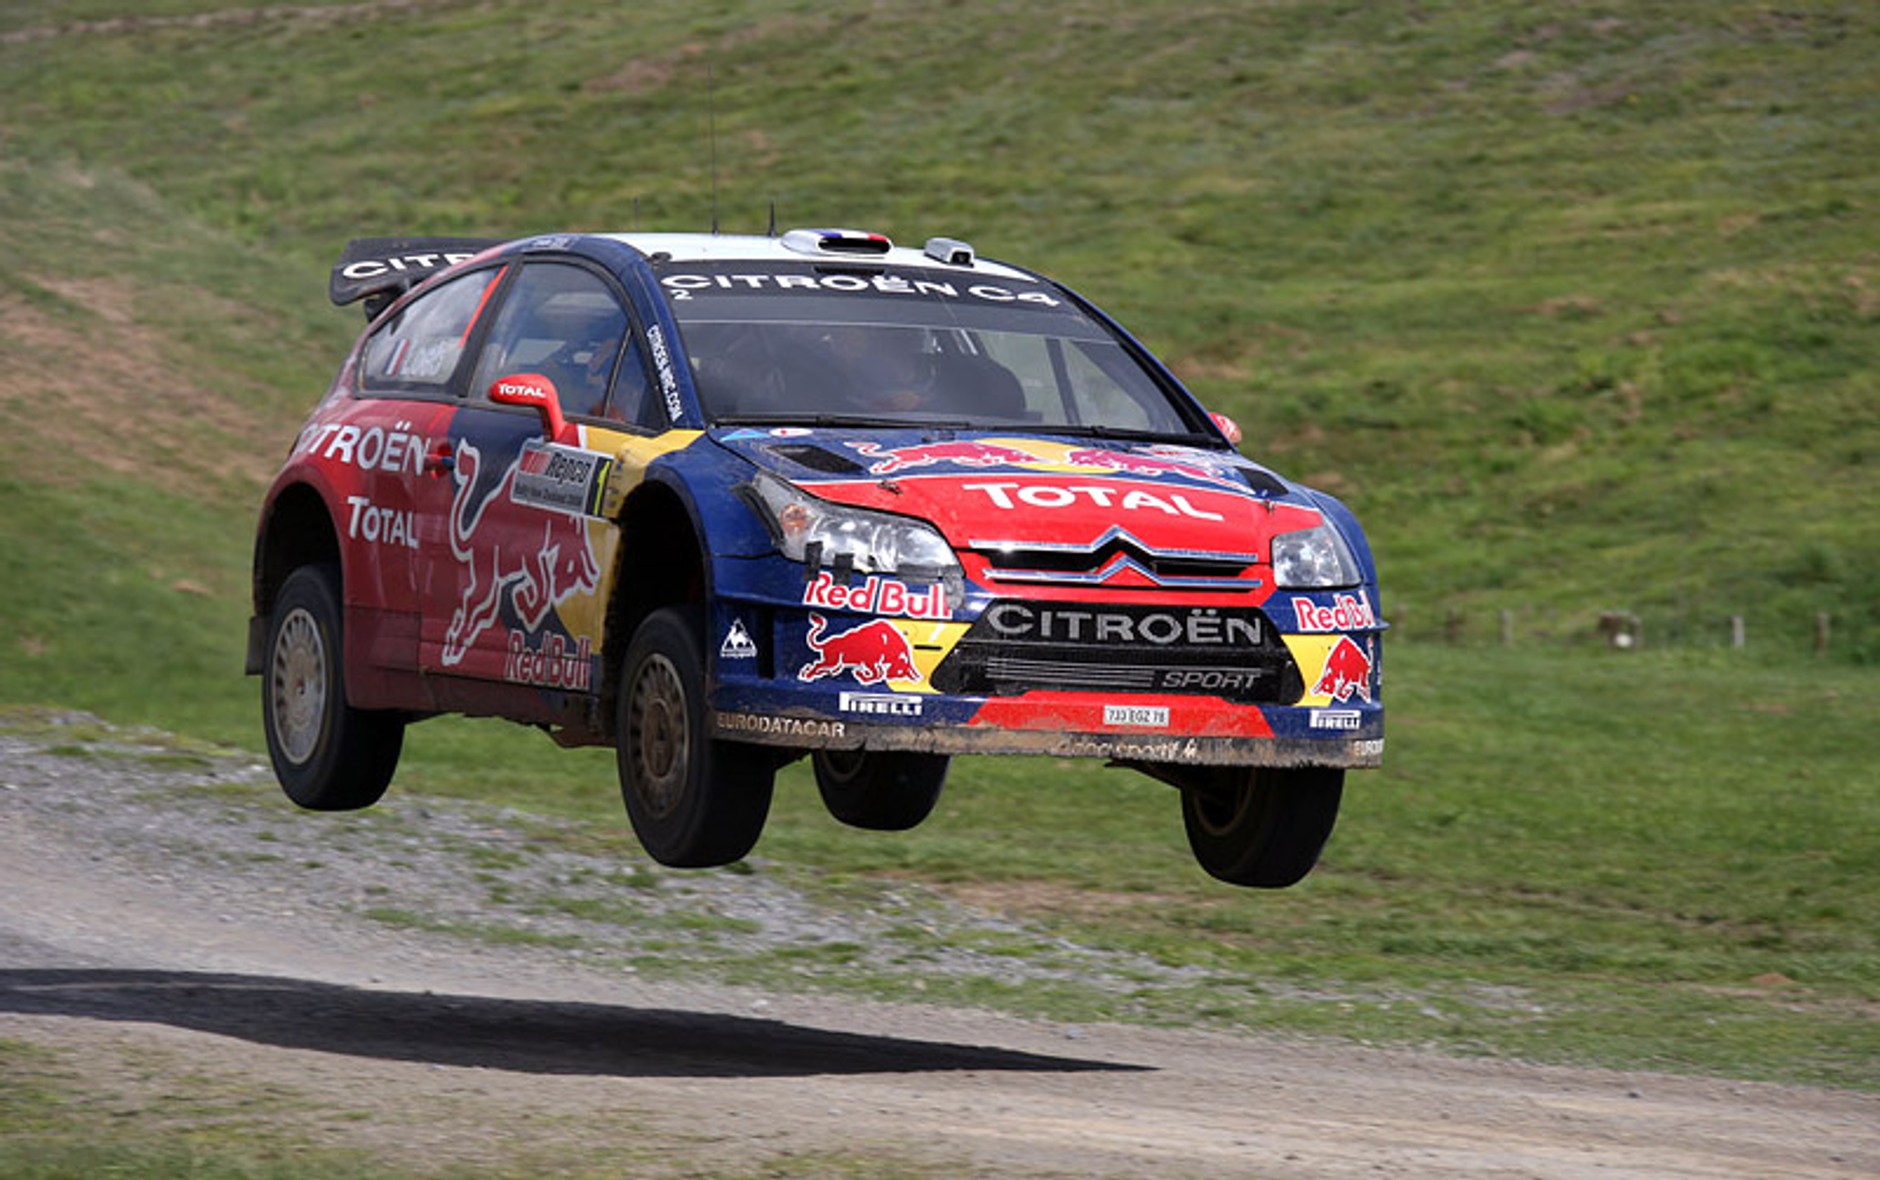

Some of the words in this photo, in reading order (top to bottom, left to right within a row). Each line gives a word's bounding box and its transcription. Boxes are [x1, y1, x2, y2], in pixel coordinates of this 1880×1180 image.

[670, 289, 693, 300] 2
[968, 285, 1061, 307] C4
[498, 383, 546, 399] TOTAL
[545, 451, 591, 485] Repco
[963, 482, 1224, 521] TOTAL
[347, 496, 419, 549] TOTAL
[803, 571, 879, 612] Red
[876, 580, 953, 619] Bull
[987, 604, 1262, 645] CITROËN
[1291, 593, 1351, 632] Red
[504, 629, 551, 684] Red
[549, 634, 592, 690] Bull
[1162, 671, 1262, 689] SPORT
[839, 692, 923, 715] PIRELLI
[716, 712, 845, 737] EURODATACAR
[1310, 710, 1361, 730] PIRELLI
